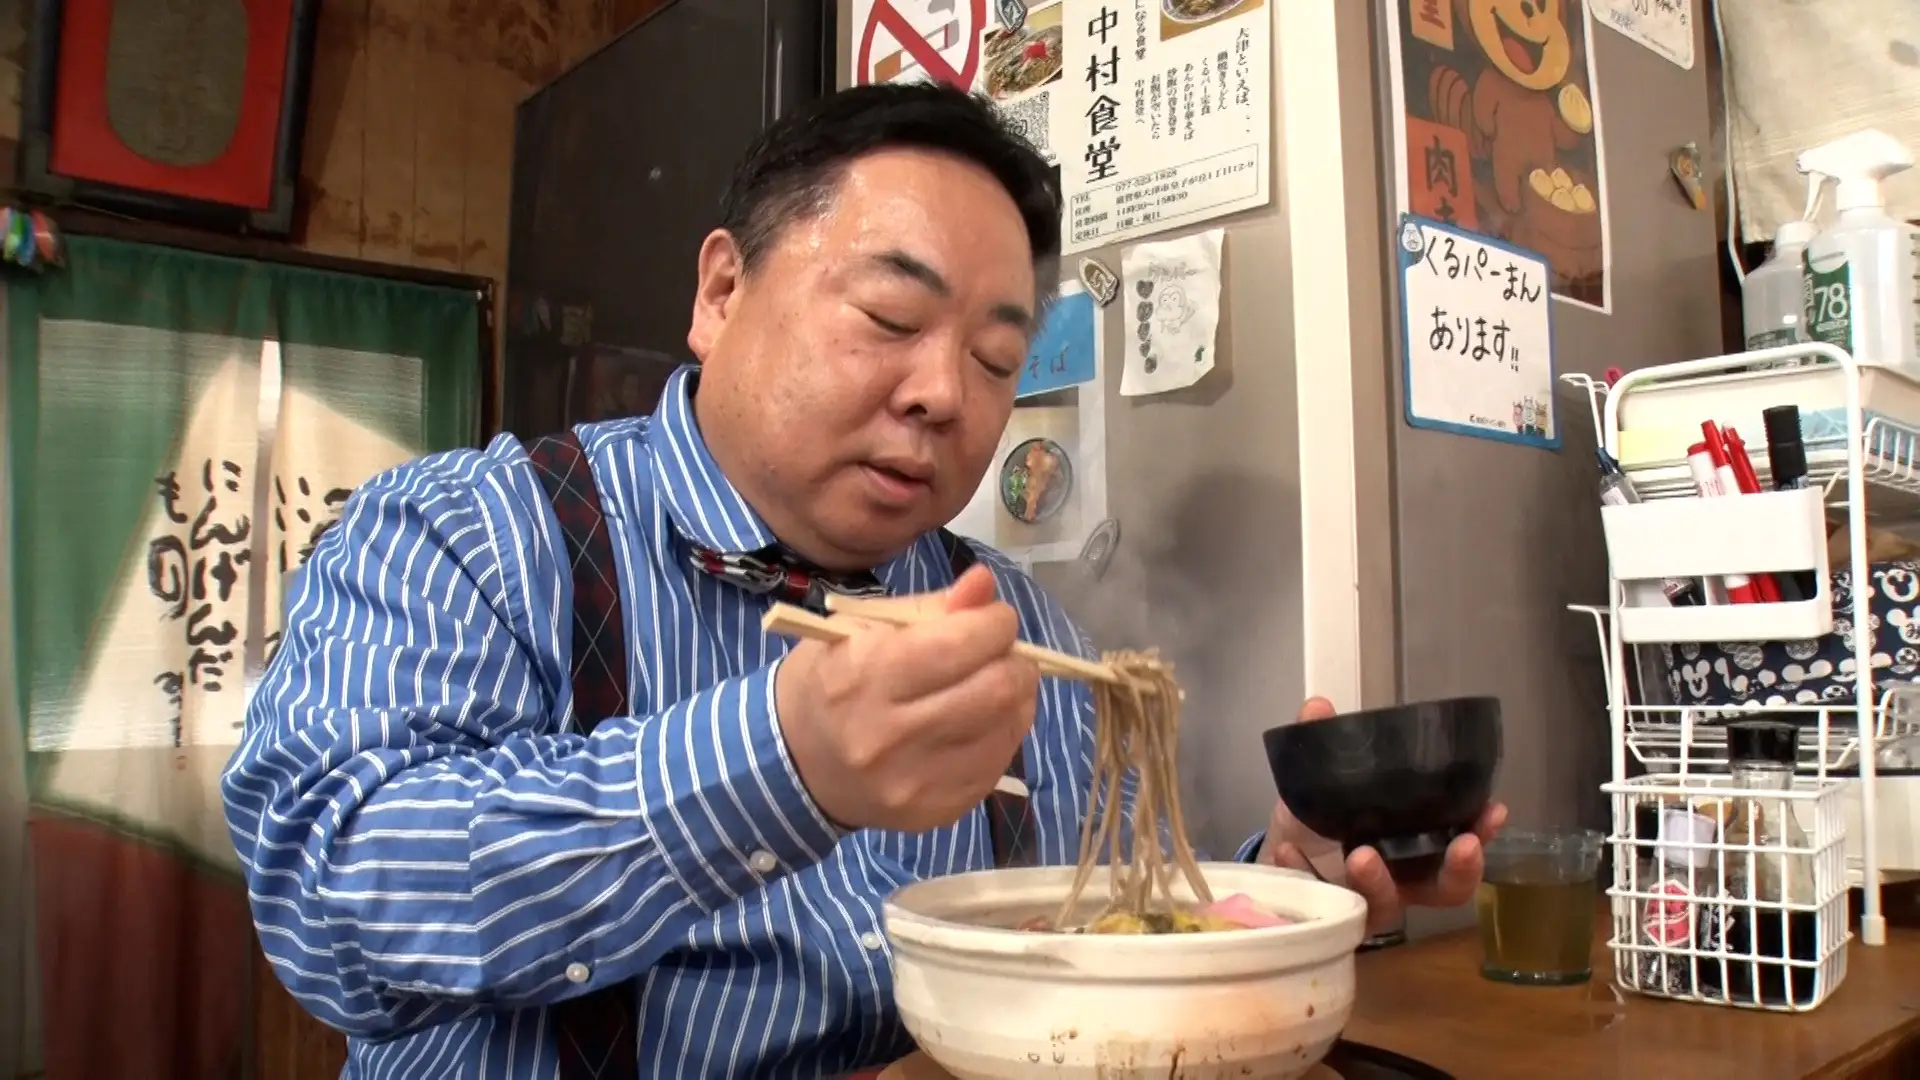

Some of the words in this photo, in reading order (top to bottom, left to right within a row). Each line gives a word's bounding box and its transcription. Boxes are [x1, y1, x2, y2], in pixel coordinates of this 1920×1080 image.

[1084, 5, 1122, 185] 中村食堂
[1425, 235, 1541, 304] くるパーまん
[1813, 282, 1848, 323] 78
